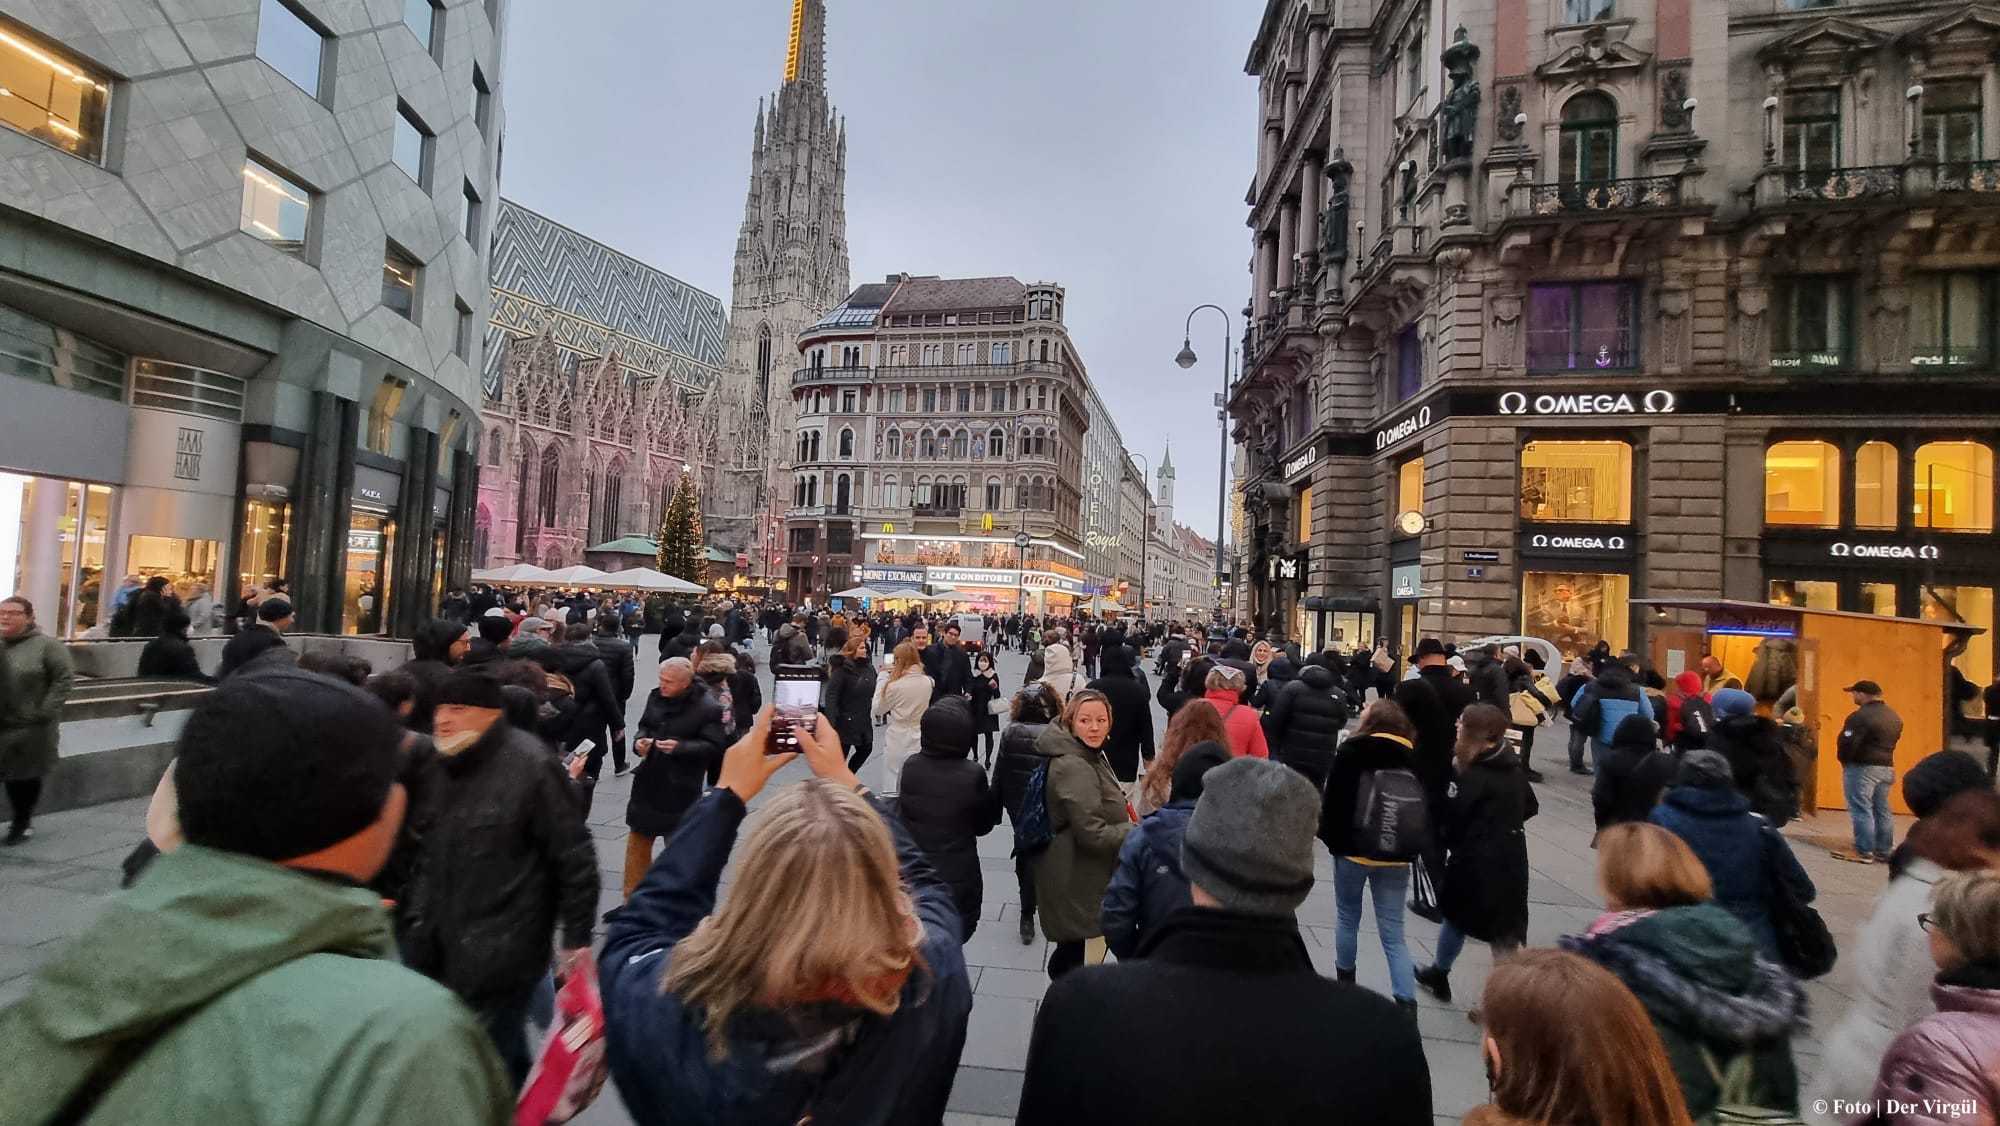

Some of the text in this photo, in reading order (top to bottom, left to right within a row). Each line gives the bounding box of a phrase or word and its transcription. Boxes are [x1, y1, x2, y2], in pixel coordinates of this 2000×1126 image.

[1535, 393, 1635, 414] OMEGA
[1386, 416, 1418, 444] OMEGA
[1291, 453, 1308, 475] OMEGA
[1090, 461, 1102, 527] HOTEL
[1085, 531, 1123, 552] Royal
[1551, 537, 1604, 548] OMEGA
[1853, 545, 1915, 558] OMEGA
[863, 569, 886, 581] MONEY
[888, 570, 924, 582] EXCHANGE
[954, 573, 1012, 582] KONDITOREI
[1381, 801, 1399, 834] PUMA
